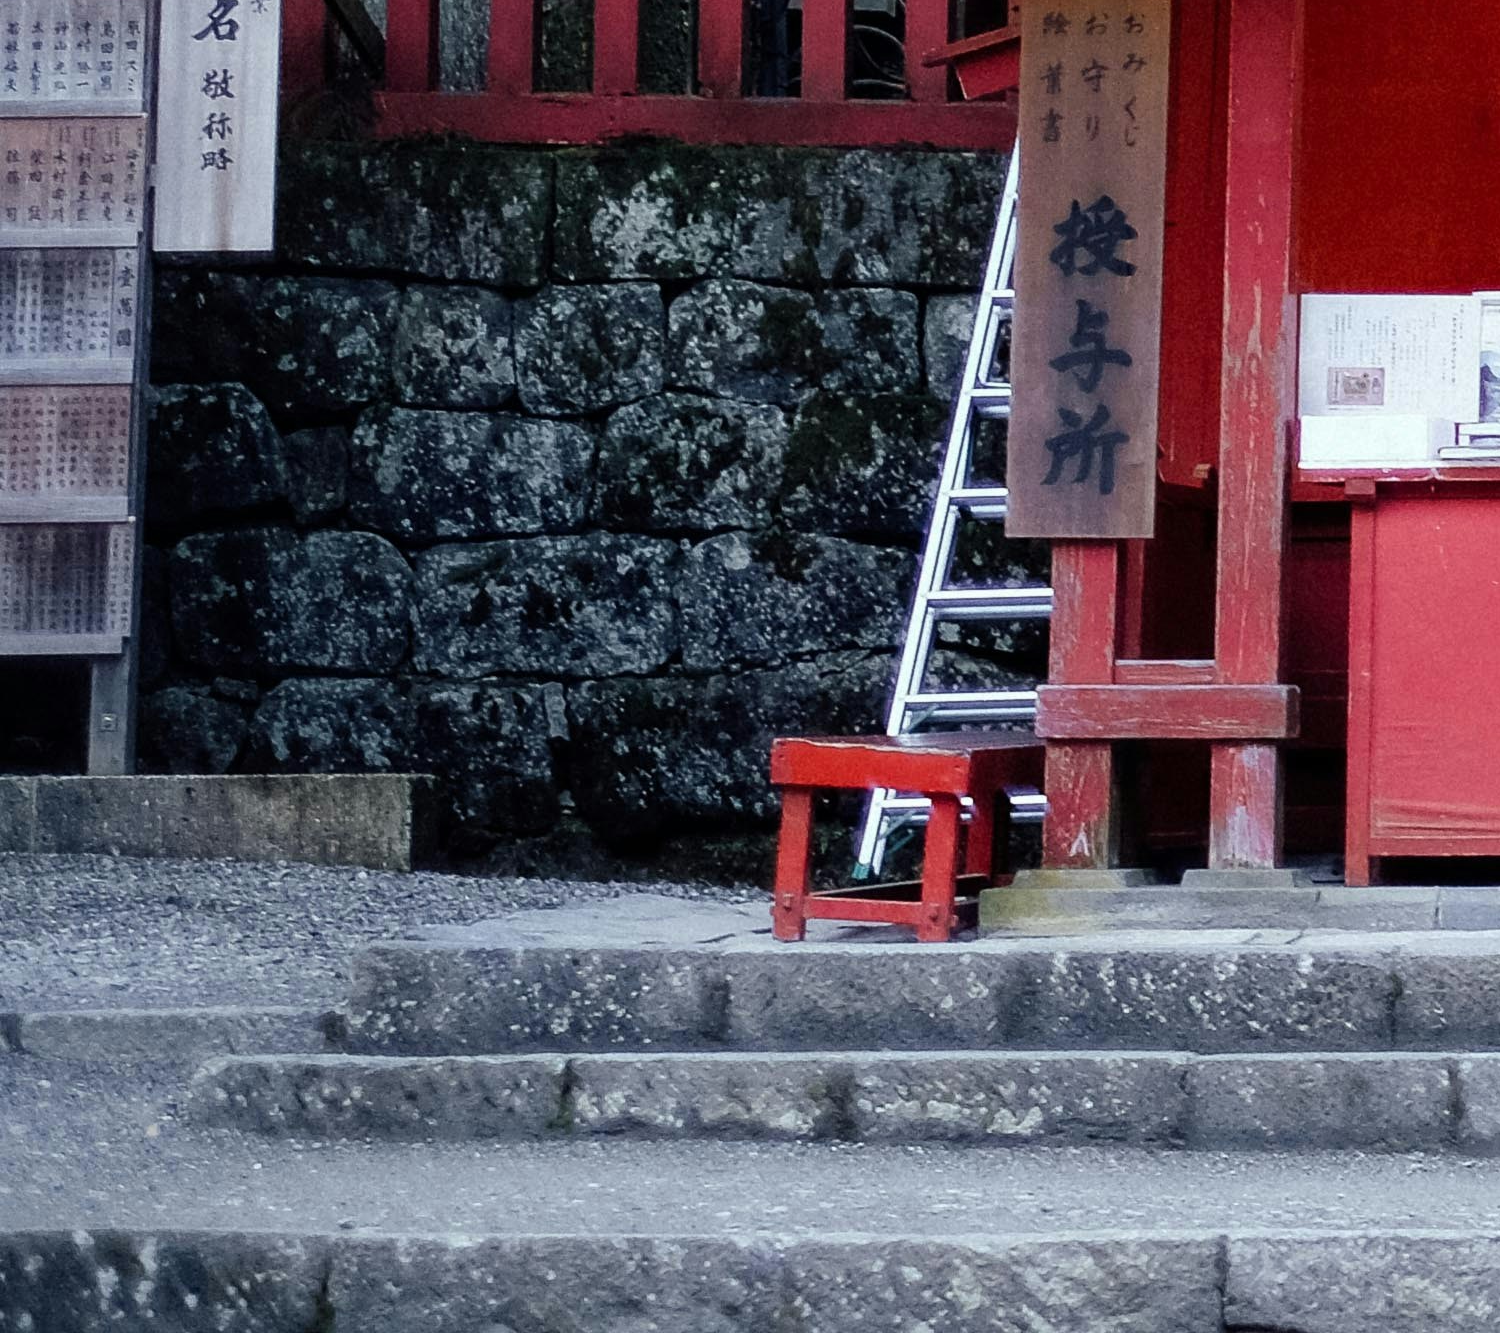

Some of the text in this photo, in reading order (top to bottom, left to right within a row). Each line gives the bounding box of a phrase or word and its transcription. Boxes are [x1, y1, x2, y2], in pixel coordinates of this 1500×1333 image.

[200, 69, 235, 171] 敬称略
[1080, 12, 1110, 143] お守り
[1121, 12, 1148, 148] おみくじ
[1039, 193, 1139, 497] 授与所
